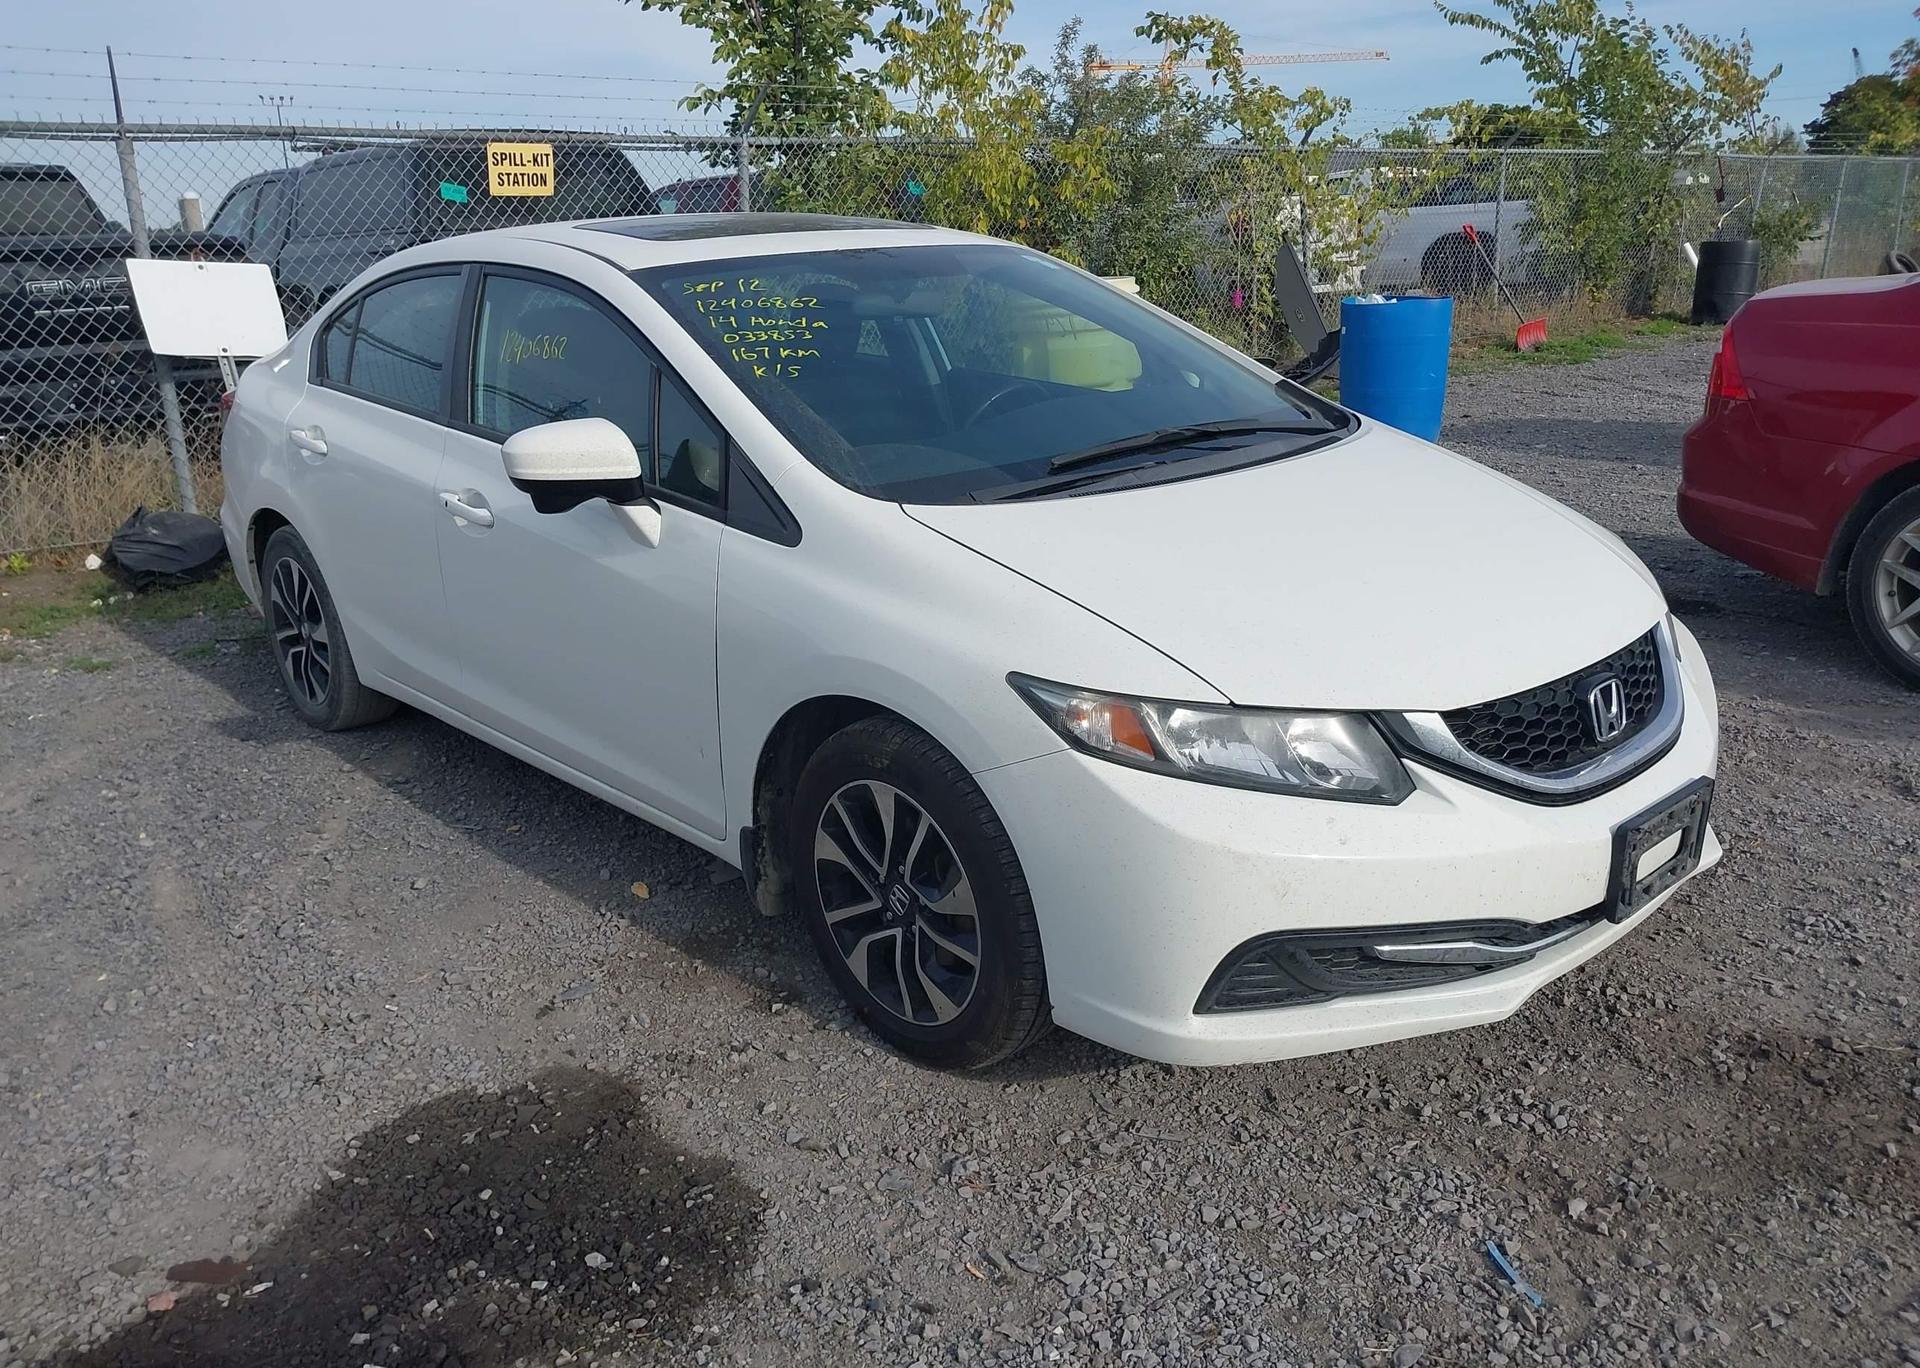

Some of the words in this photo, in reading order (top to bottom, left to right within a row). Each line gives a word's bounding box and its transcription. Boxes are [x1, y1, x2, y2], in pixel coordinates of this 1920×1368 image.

[491, 152, 551, 167] SPILL-KIT
[497, 172, 548, 187] STATION
[27, 277, 128, 296] GMC
[738, 278, 769, 293] 12
[696, 297, 826, 313] 12406862
[709, 316, 738, 328] 14
[751, 315, 829, 329] Honda
[723, 330, 813, 343] 033853
[731, 346, 770, 361] 167
